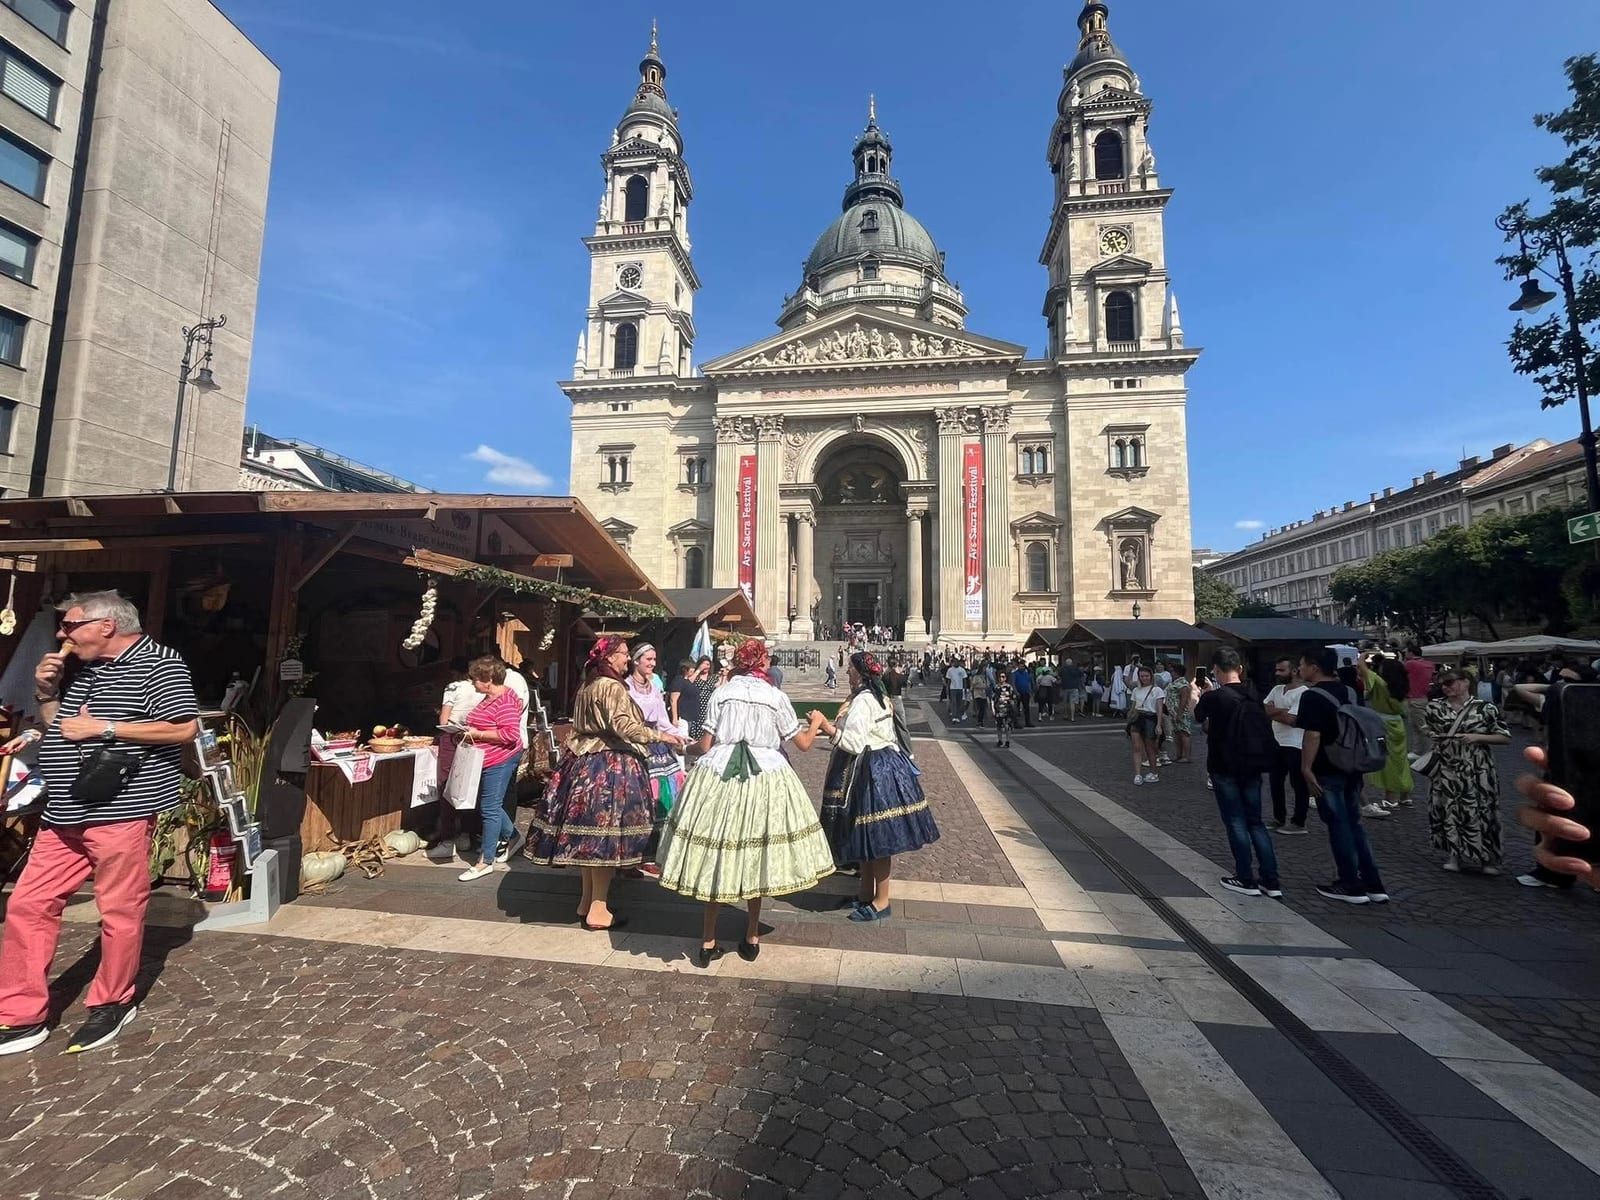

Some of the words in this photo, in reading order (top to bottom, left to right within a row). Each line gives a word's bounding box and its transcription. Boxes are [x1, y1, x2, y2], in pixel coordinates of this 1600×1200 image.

[743, 476, 752, 518] Fesztivál
[968, 466, 978, 509] Fesztivál
[742, 521, 751, 548] Sacra
[968, 512, 978, 540] Sacra
[742, 550, 751, 567] Ars
[968, 543, 978, 560] Ars
